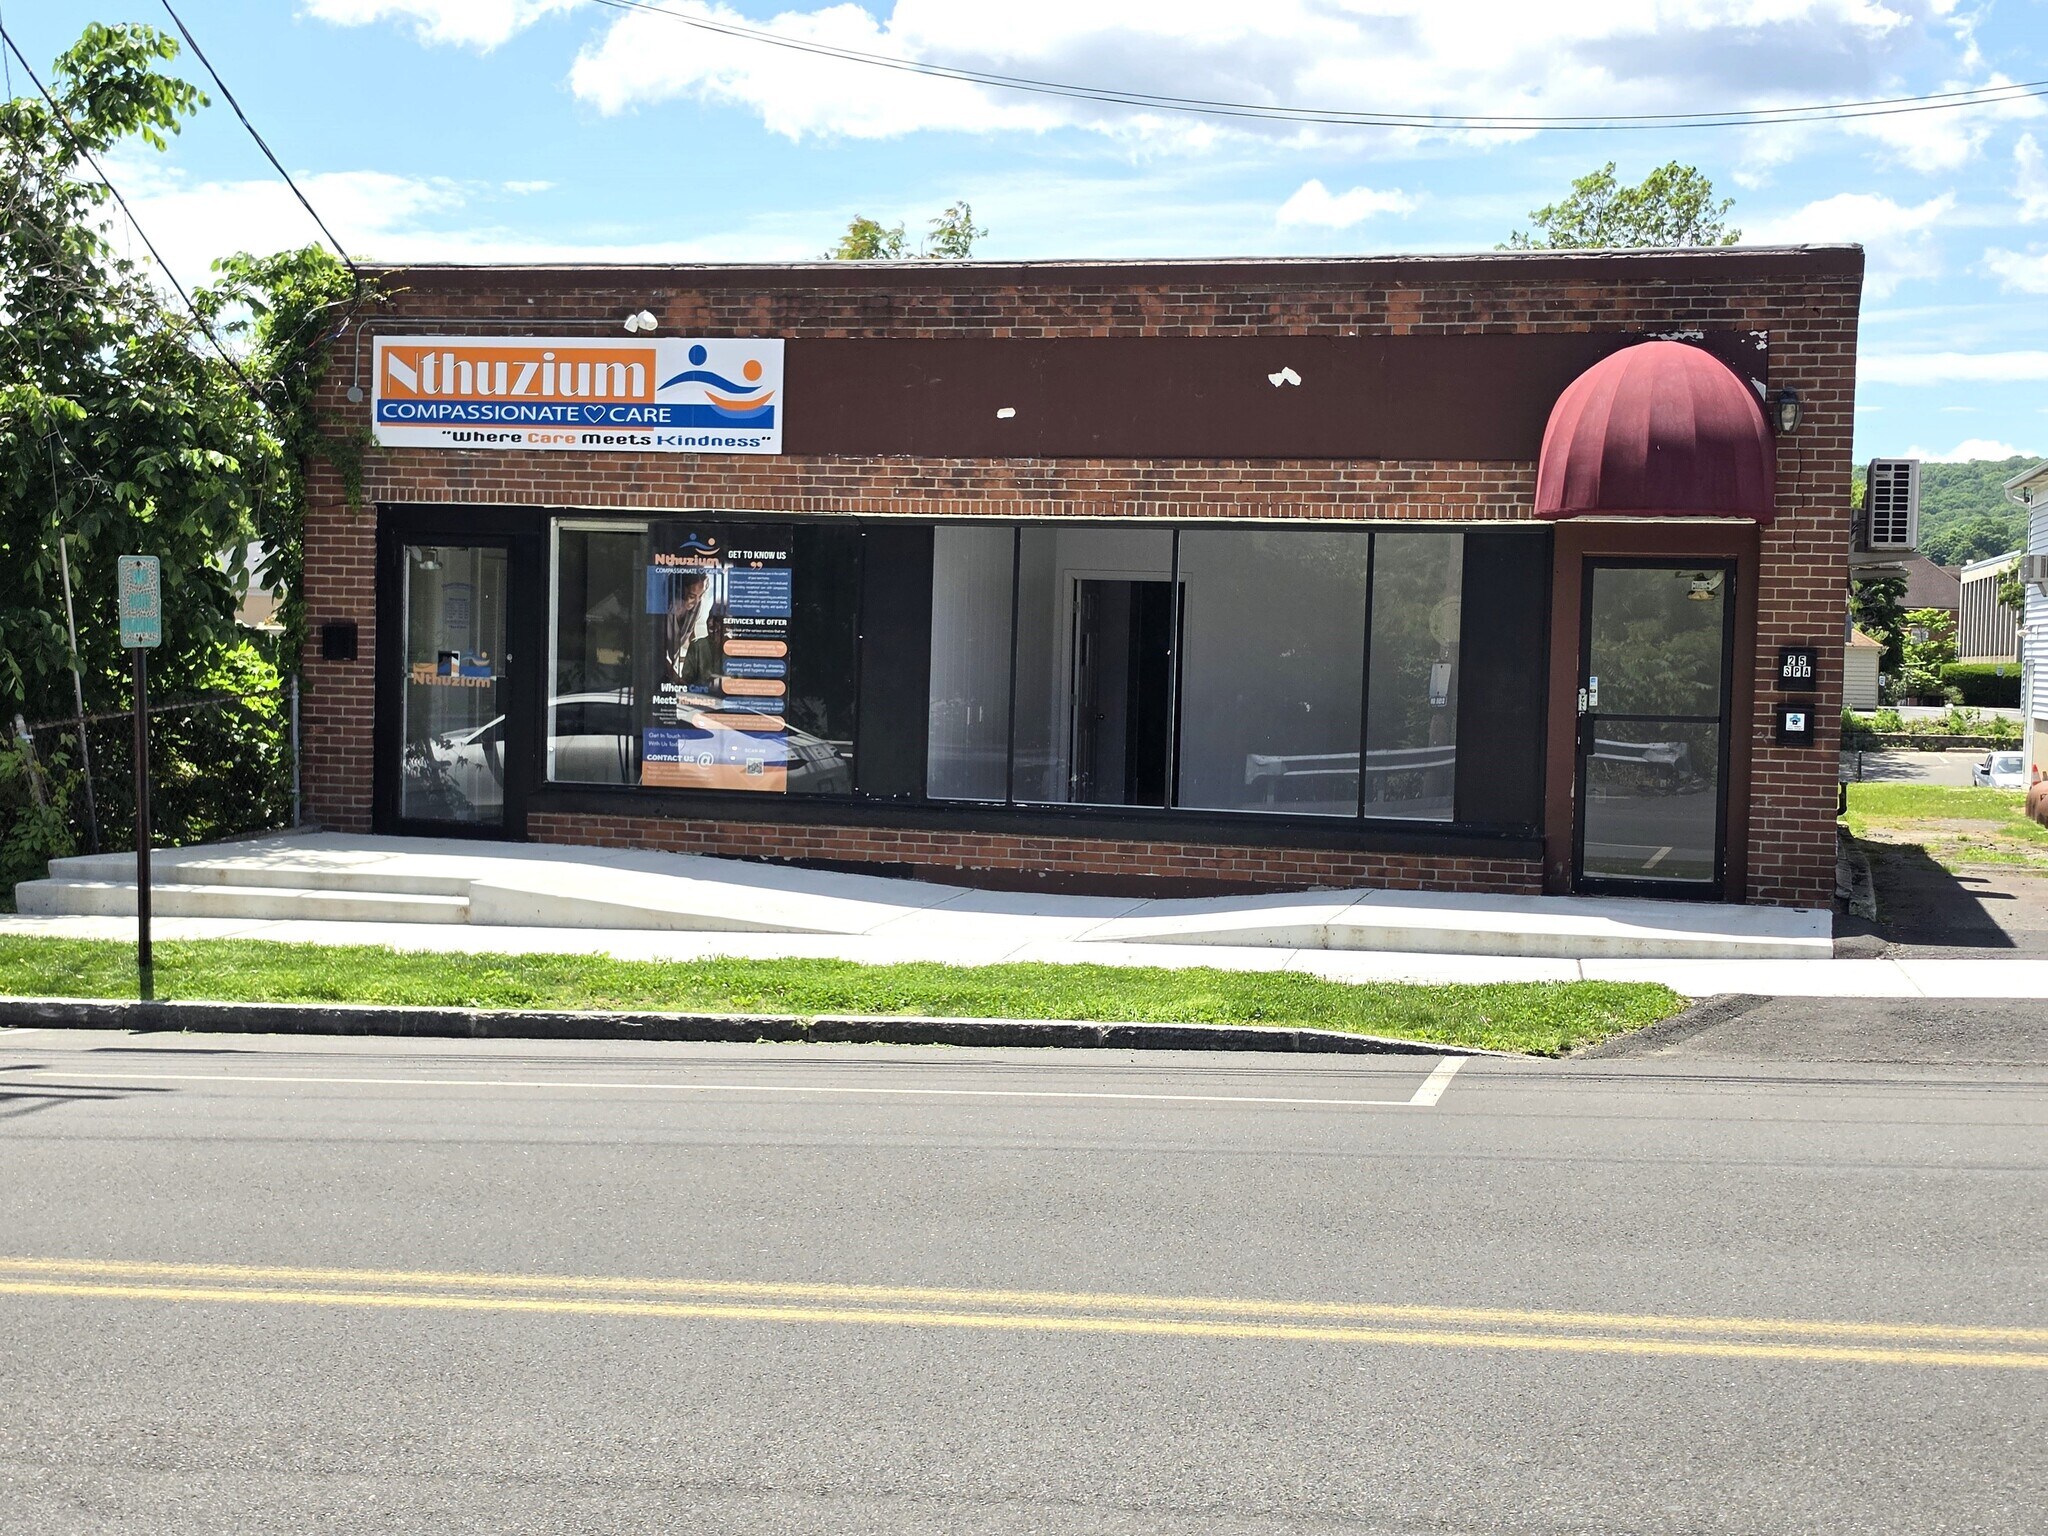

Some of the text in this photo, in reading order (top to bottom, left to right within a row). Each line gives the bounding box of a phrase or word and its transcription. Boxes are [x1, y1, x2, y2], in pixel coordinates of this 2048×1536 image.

[386, 350, 647, 398] Nthuzium
[382, 403, 672, 424] COMPASSIONATE CARE
[527, 432, 577, 445] Care
[654, 553, 720, 567] Nthuzium
[728, 550, 786, 560] GET TO KNOW US
[655, 567, 697, 575] COMPASSIONATE
[723, 617, 754, 626] SERVICES
[766, 619, 787, 627] OFFER
[1788, 656, 1806, 666] 25
[1784, 667, 1810, 677] SPA
[412, 671, 491, 689] Nthuzium
[660, 683, 709, 693] Where Care
[652, 695, 677, 705] Meets
[646, 753, 682, 762] CONTACT
